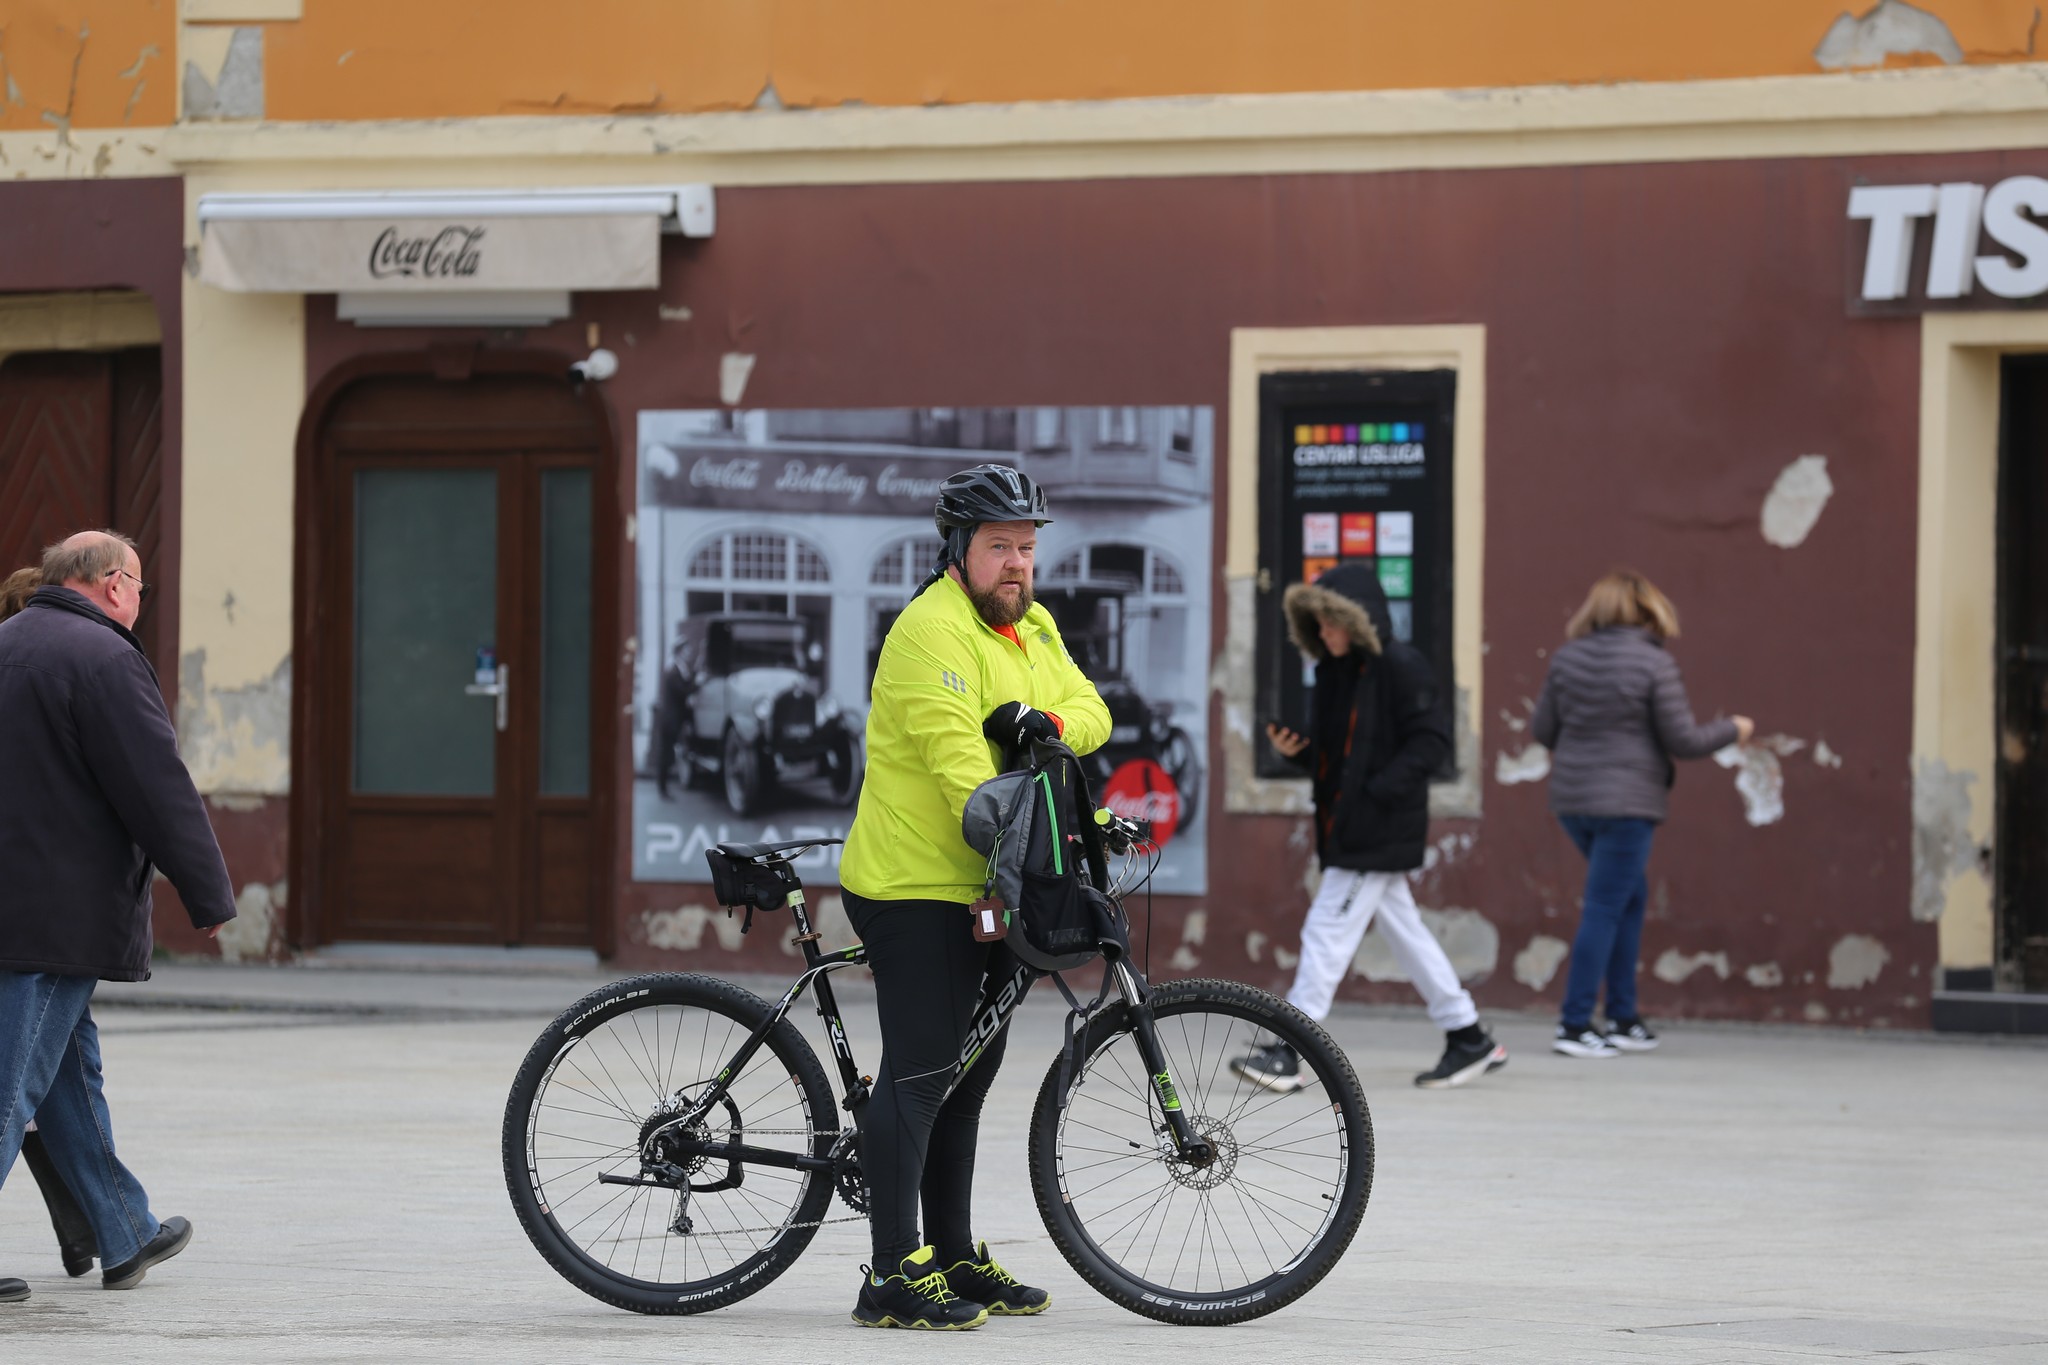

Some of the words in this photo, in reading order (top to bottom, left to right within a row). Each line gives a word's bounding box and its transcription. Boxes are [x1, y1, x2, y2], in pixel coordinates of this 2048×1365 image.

[369, 225, 488, 279] Coca-Cola
[1293, 445, 1357, 466] CENTAR
[1359, 443, 1425, 464] USLUGA
[563, 988, 650, 1036] SCHWALBE
[1152, 993, 1197, 1008] SAM
[1203, 994, 1275, 1017] SMART
[678, 1084, 719, 1130] NATURAL
[718, 1067, 731, 1083] 30
[677, 1281, 734, 1304] SMART
[739, 1260, 770, 1284] SAM
[1142, 1290, 1266, 1312] SCHWALBE
